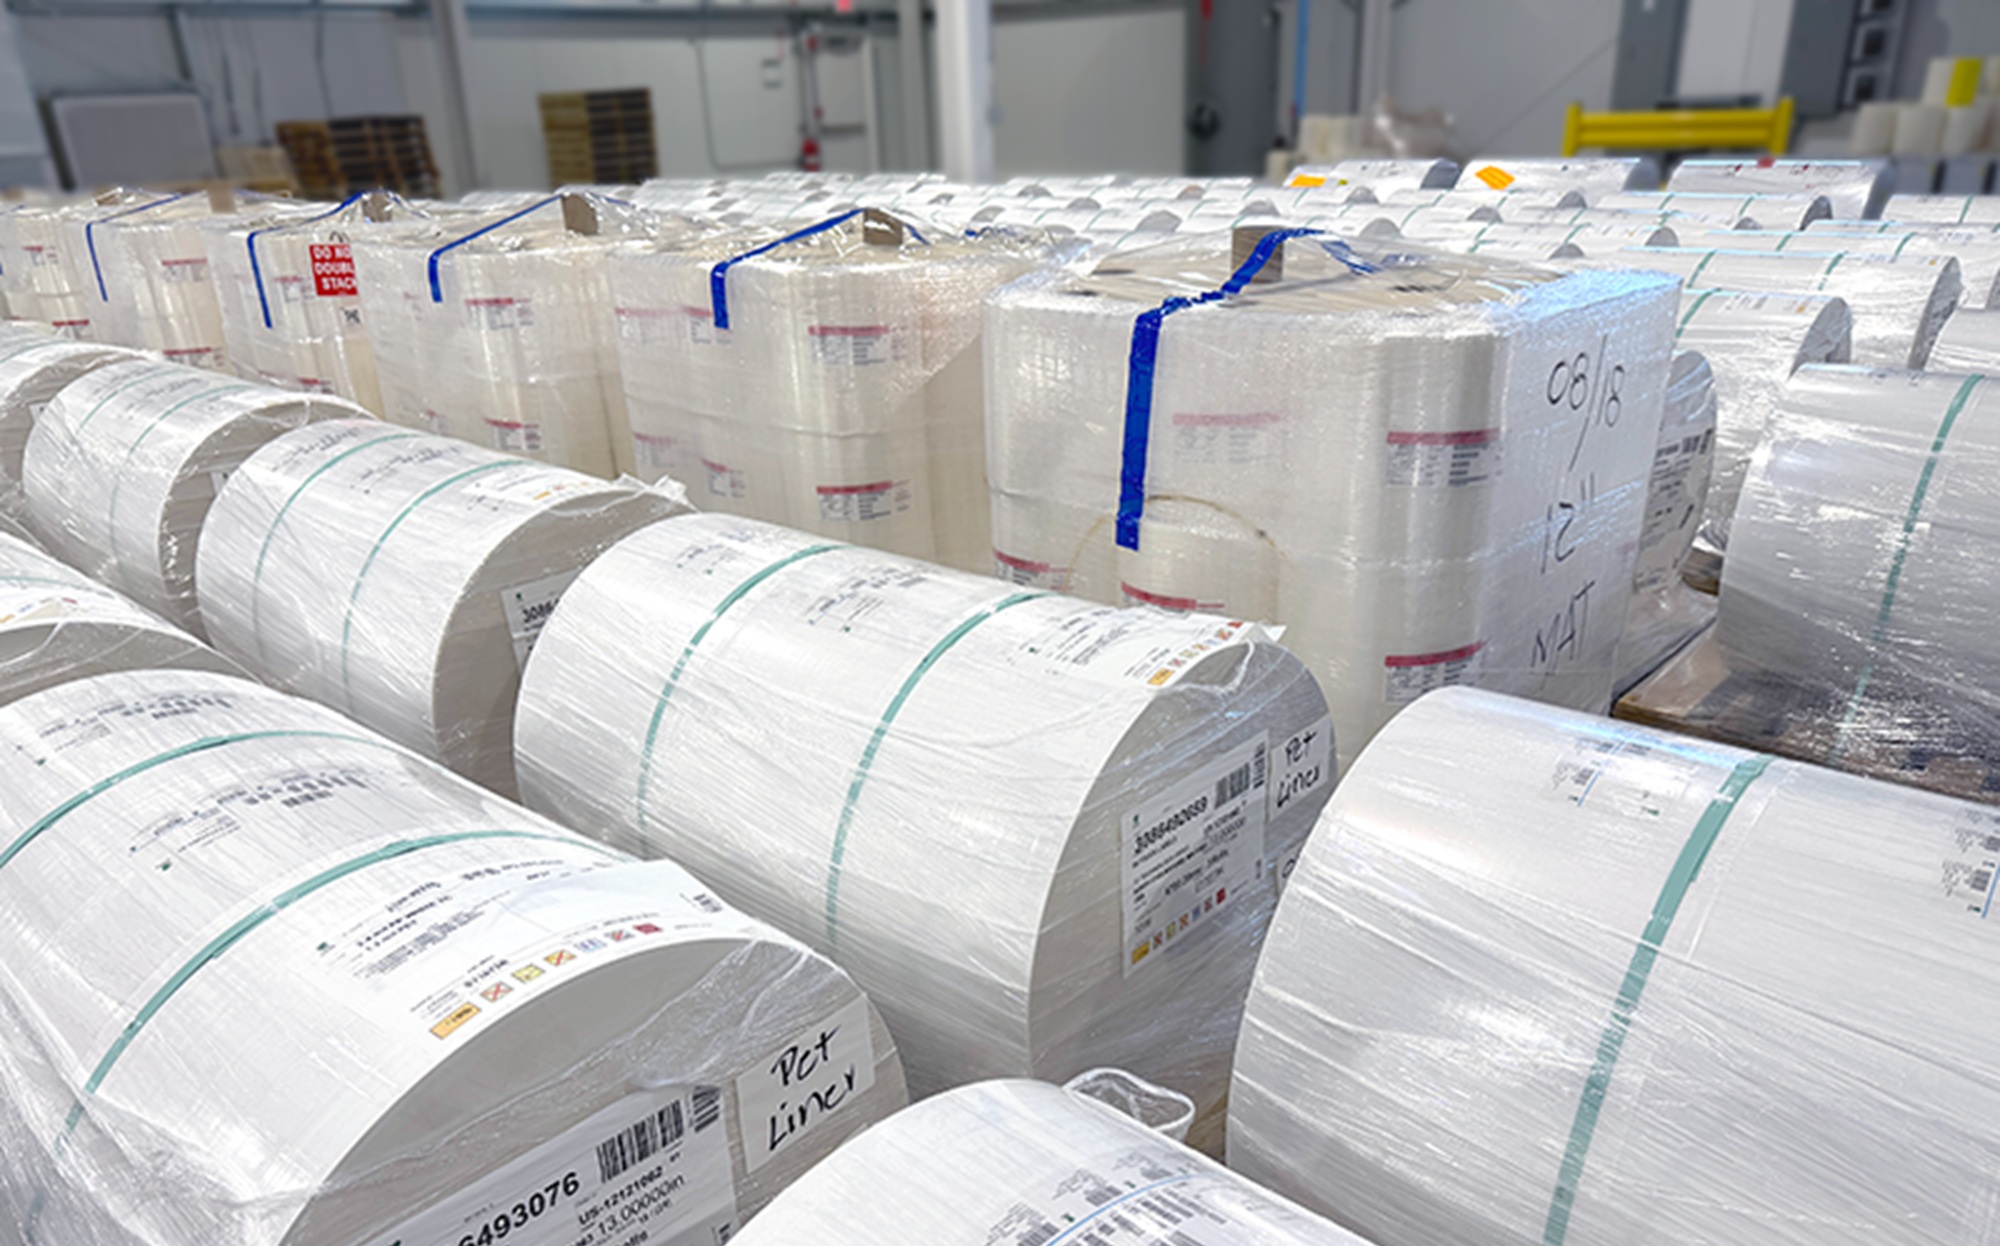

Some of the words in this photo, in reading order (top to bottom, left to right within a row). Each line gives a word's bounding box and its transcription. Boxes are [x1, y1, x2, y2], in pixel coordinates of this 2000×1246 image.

[313, 246, 332, 259] DO
[335, 246, 351, 259] NO
[314, 261, 355, 275] DOUBL
[770, 1024, 842, 1086] Pet
[769, 1063, 856, 1151] Liner
